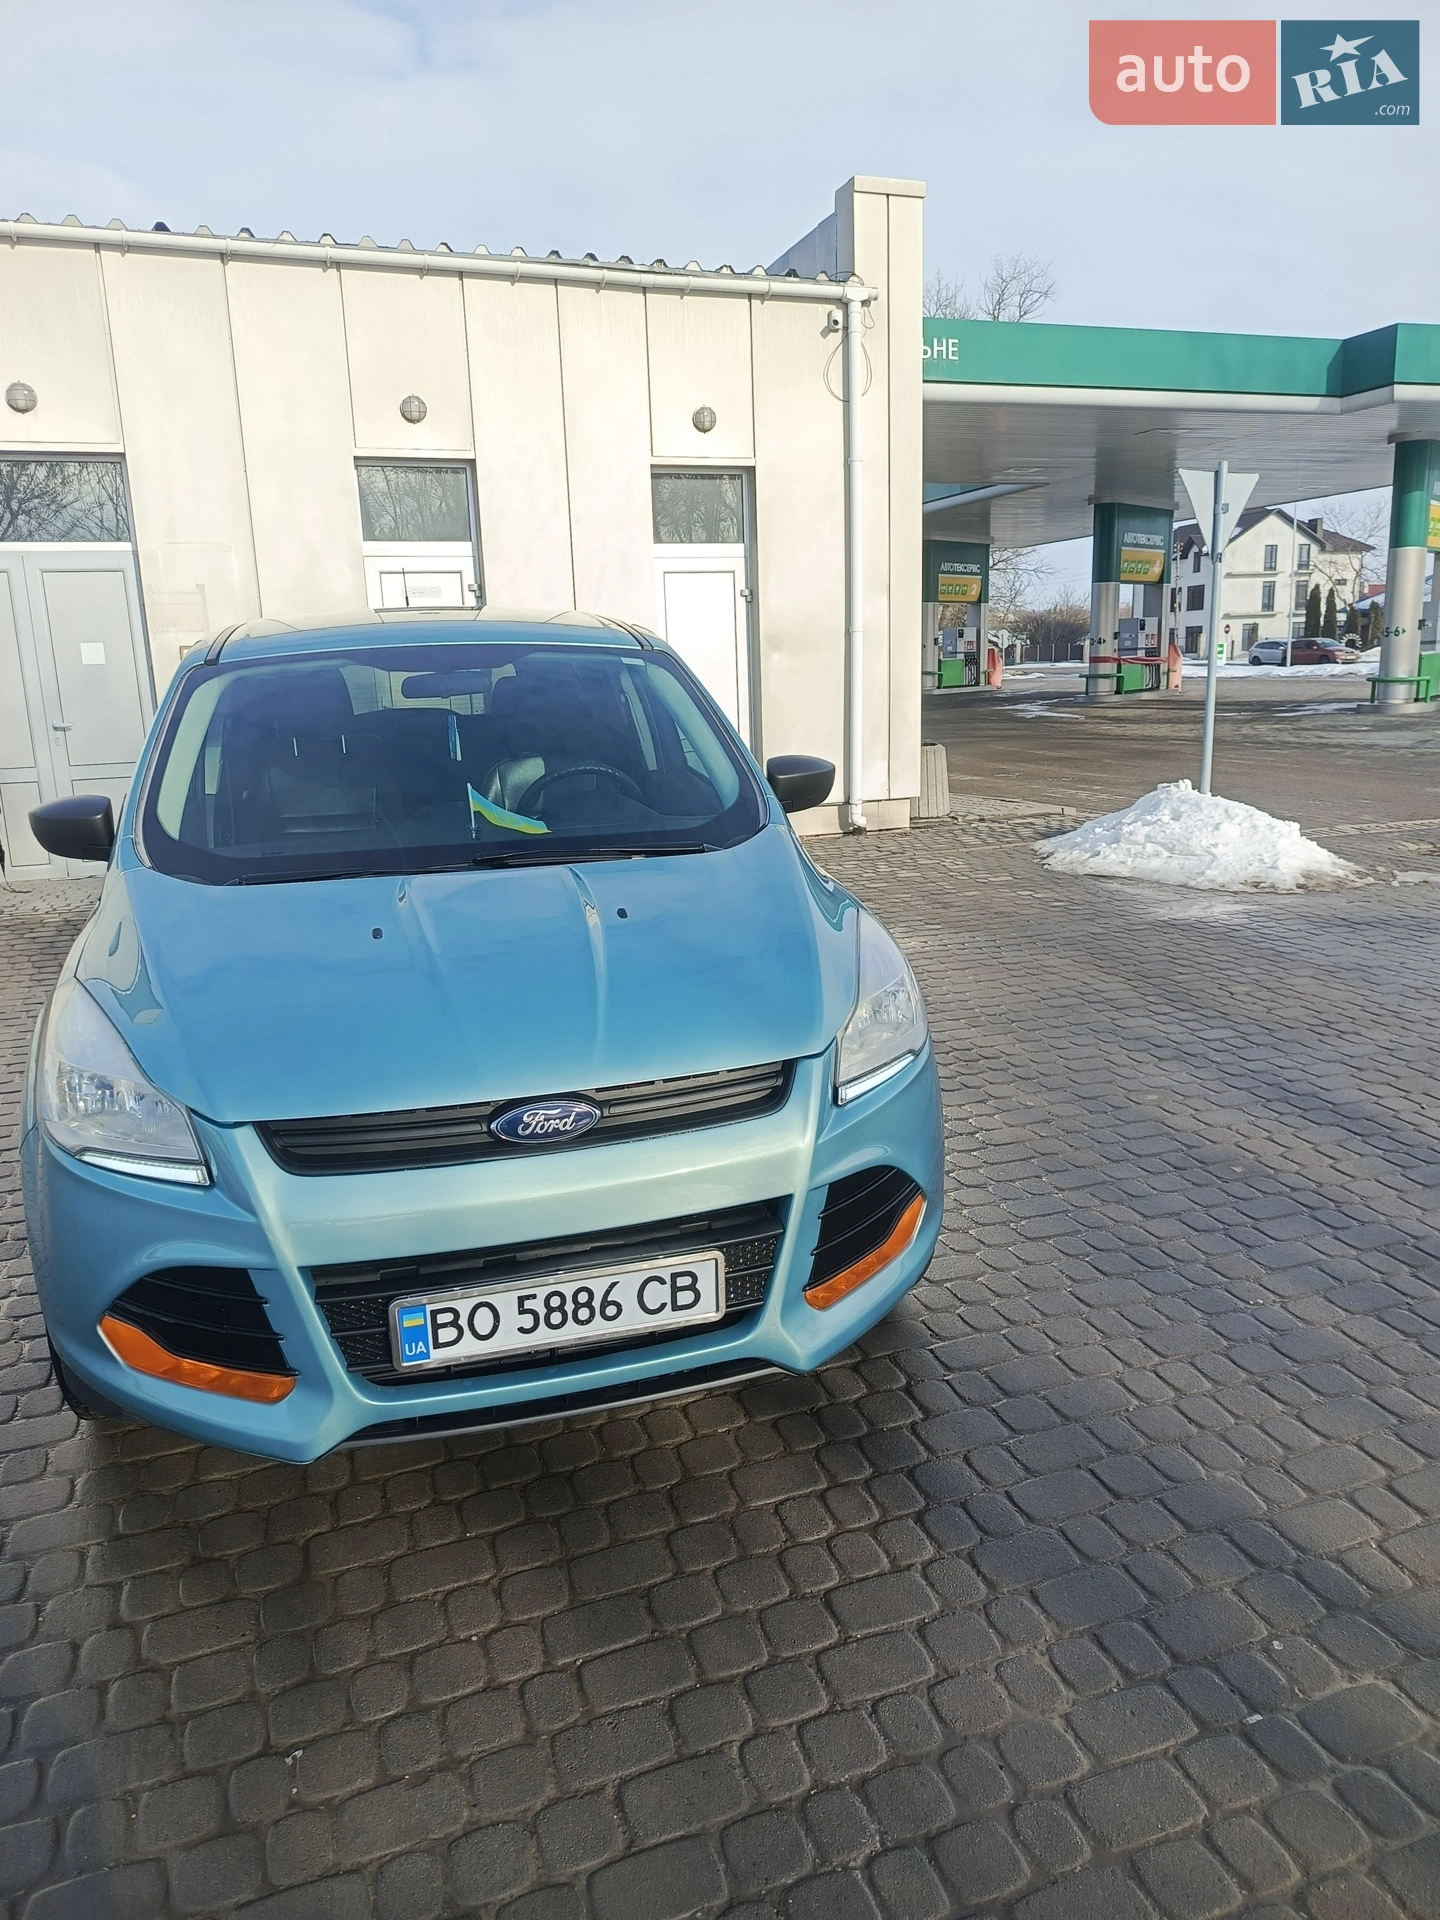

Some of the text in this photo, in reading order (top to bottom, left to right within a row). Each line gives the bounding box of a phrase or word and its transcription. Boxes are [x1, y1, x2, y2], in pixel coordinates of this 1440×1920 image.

[970, 583, 978, 596] 2
[517, 1108, 577, 1136] Ford
[429, 1269, 702, 1350] BO 5886 CB
[404, 1343, 427, 1357] UA
